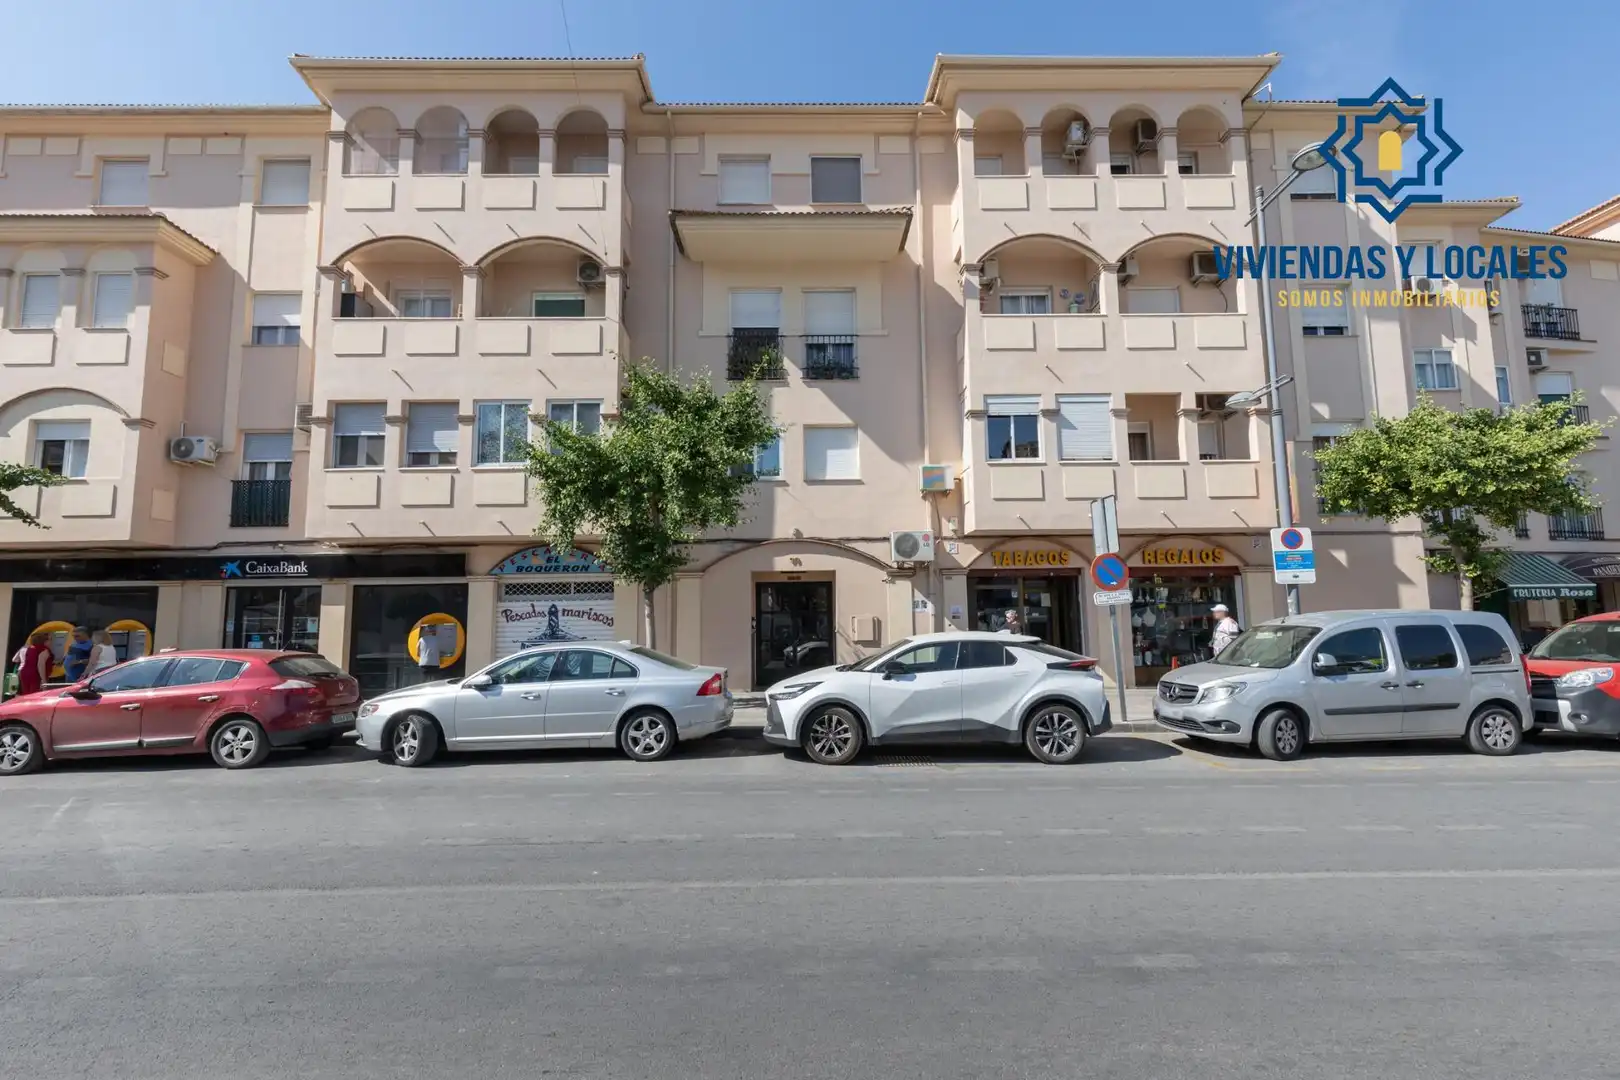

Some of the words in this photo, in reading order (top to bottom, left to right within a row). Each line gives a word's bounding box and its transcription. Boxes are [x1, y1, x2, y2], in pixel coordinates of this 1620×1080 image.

[546, 556, 560, 564] EL
[991, 550, 1071, 567] TABACOS
[1142, 546, 1225, 565] REGALOS
[245, 560, 308, 574] CaixaBank
[516, 564, 590, 573] BOQUERON
[1513, 588, 1556, 598] FRUTERIA
[1560, 588, 1594, 597] Rosa
[501, 603, 546, 623] Pescados
[562, 608, 614, 628] mariscos
